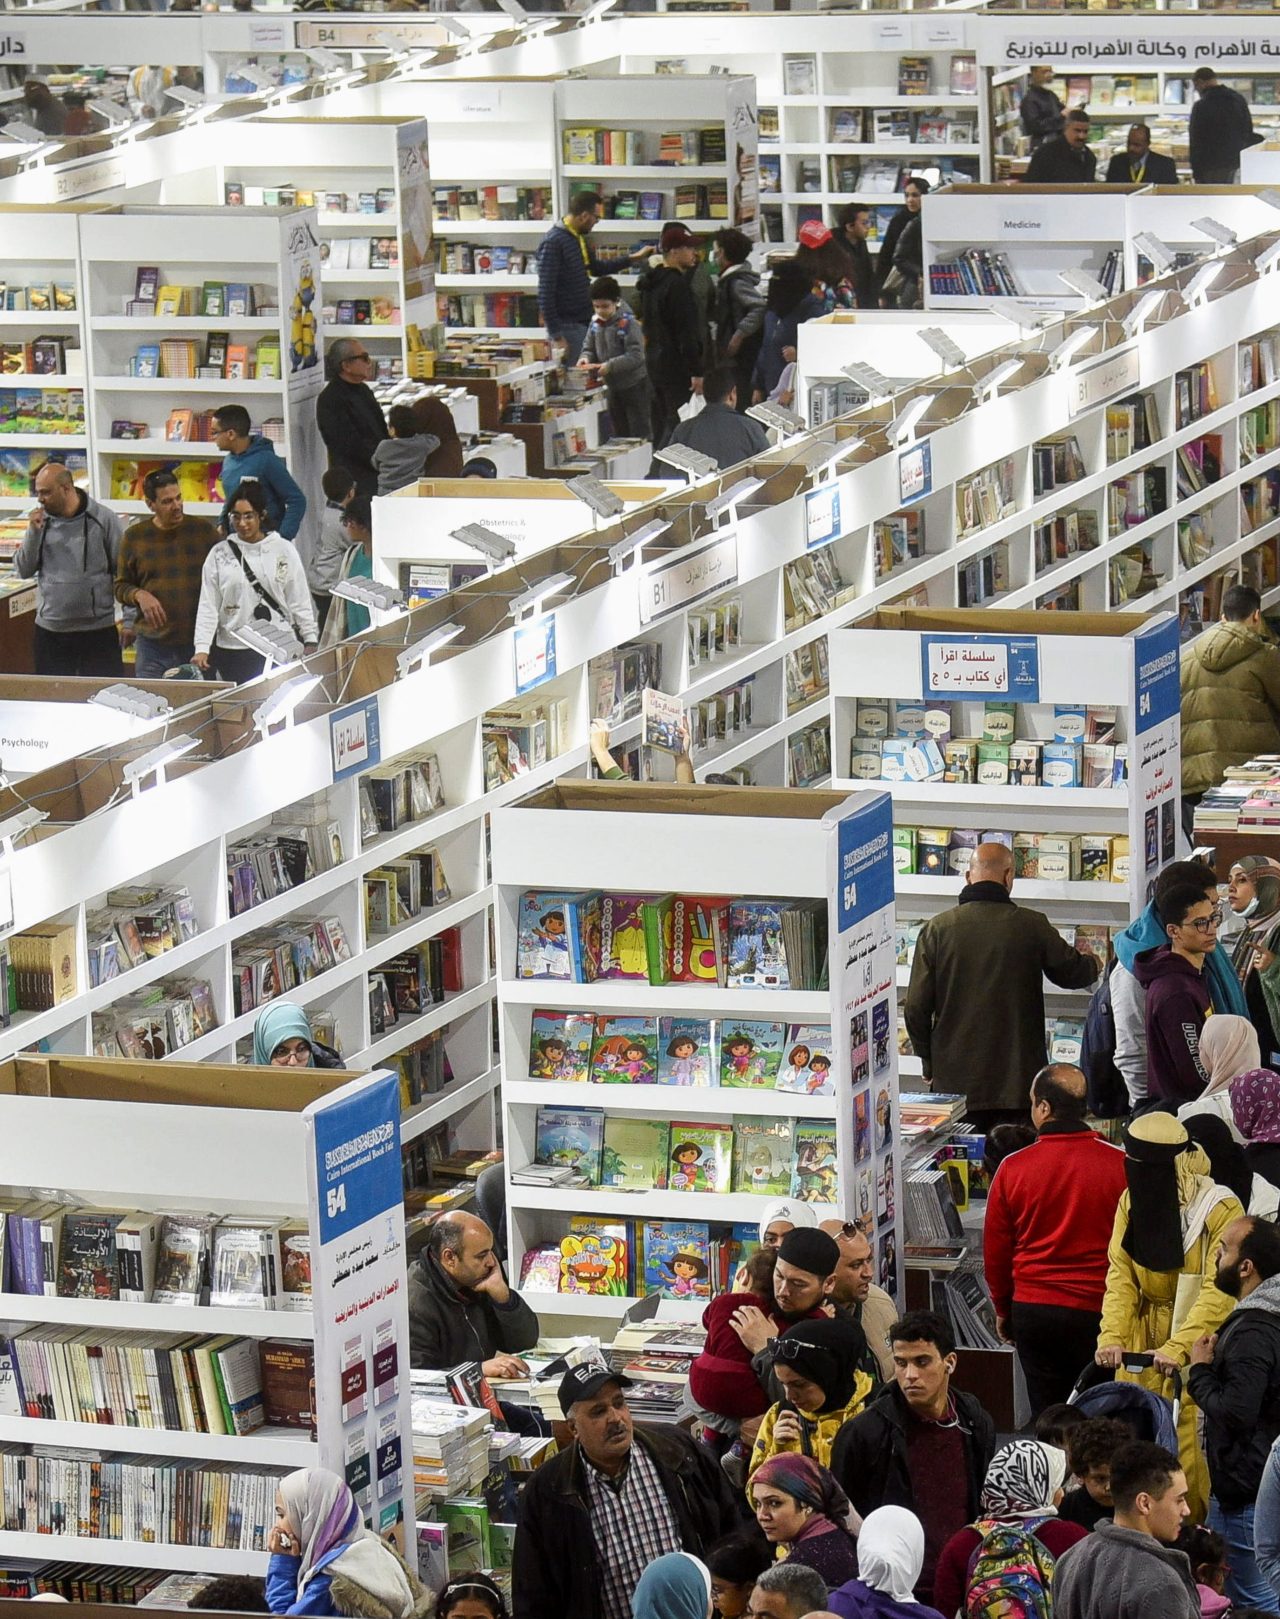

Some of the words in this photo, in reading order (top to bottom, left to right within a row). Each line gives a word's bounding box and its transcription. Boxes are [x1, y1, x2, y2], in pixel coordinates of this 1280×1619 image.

[318, 29, 335, 42] B4
[1004, 40, 1068, 60] للتوزيع
[1070, 40, 1133, 59] الأهرام
[1136, 40, 1187, 59] وكالة
[1193, 40, 1256, 59] الأهرام
[1003, 220, 1041, 229] Medicine
[845, 395, 869, 405] HEAR
[479, 518, 518, 527] Obstetrics
[653, 580, 666, 606] B1
[940, 647, 958, 664] اقرأ
[961, 650, 996, 662] سلسلة
[931, 672, 939, 686] ج
[965, 670, 990, 686] كتاب
[994, 668, 1006, 689] أي
[1139, 691, 1150, 717] 54
[1, 737, 49, 749] Psychology
[843, 882, 857, 911] 54
[326, 1169, 341, 1184] Cairo
[340, 1153, 373, 1178] International
[372, 1146, 385, 1161] Book
[384, 1141, 395, 1154] Fair
[326, 1183, 347, 1219] 54
[364, 1253, 379, 1267] سعيد
[331, 1266, 352, 1288] مصطفى
